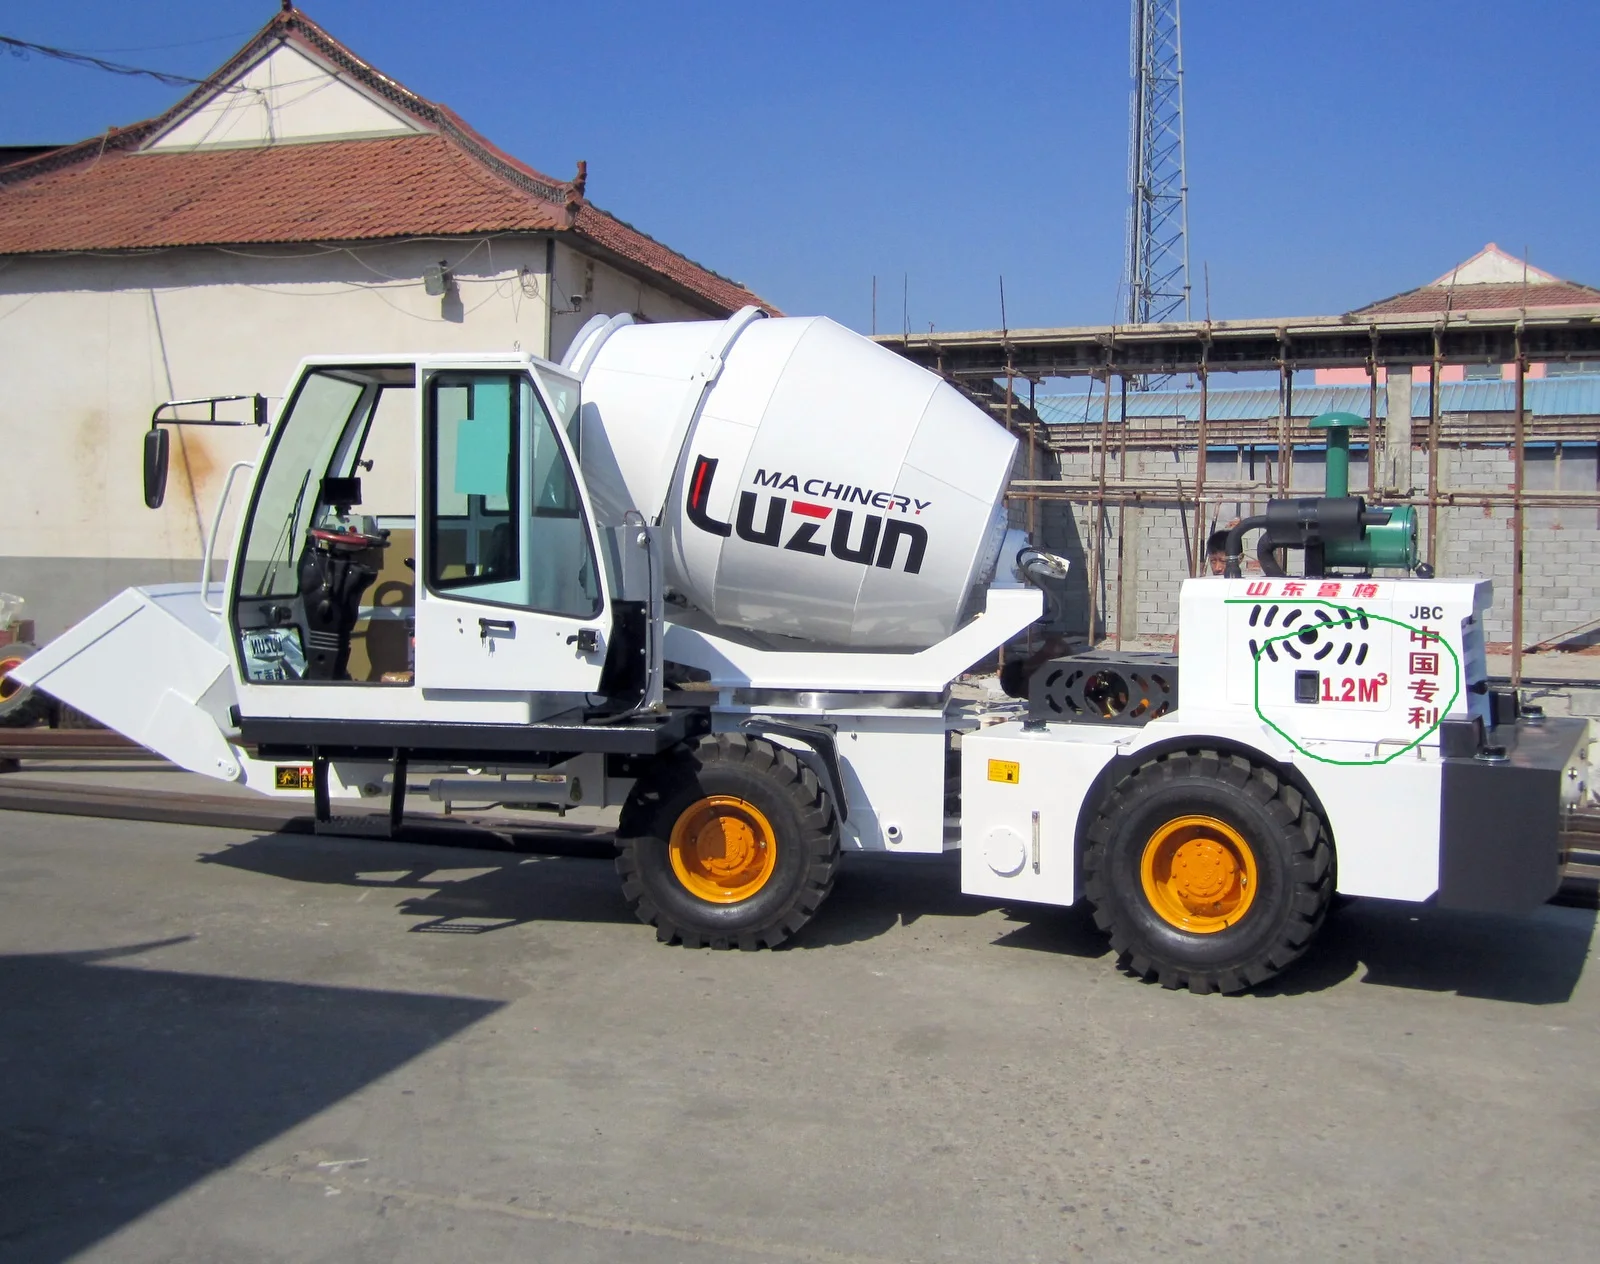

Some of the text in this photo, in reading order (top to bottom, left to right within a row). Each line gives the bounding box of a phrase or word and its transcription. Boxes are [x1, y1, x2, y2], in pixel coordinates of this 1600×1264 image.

[753, 469, 932, 515] MACHINERY
[1409, 606, 1443, 620] JBC
[1407, 626, 1440, 730] 中国专利
